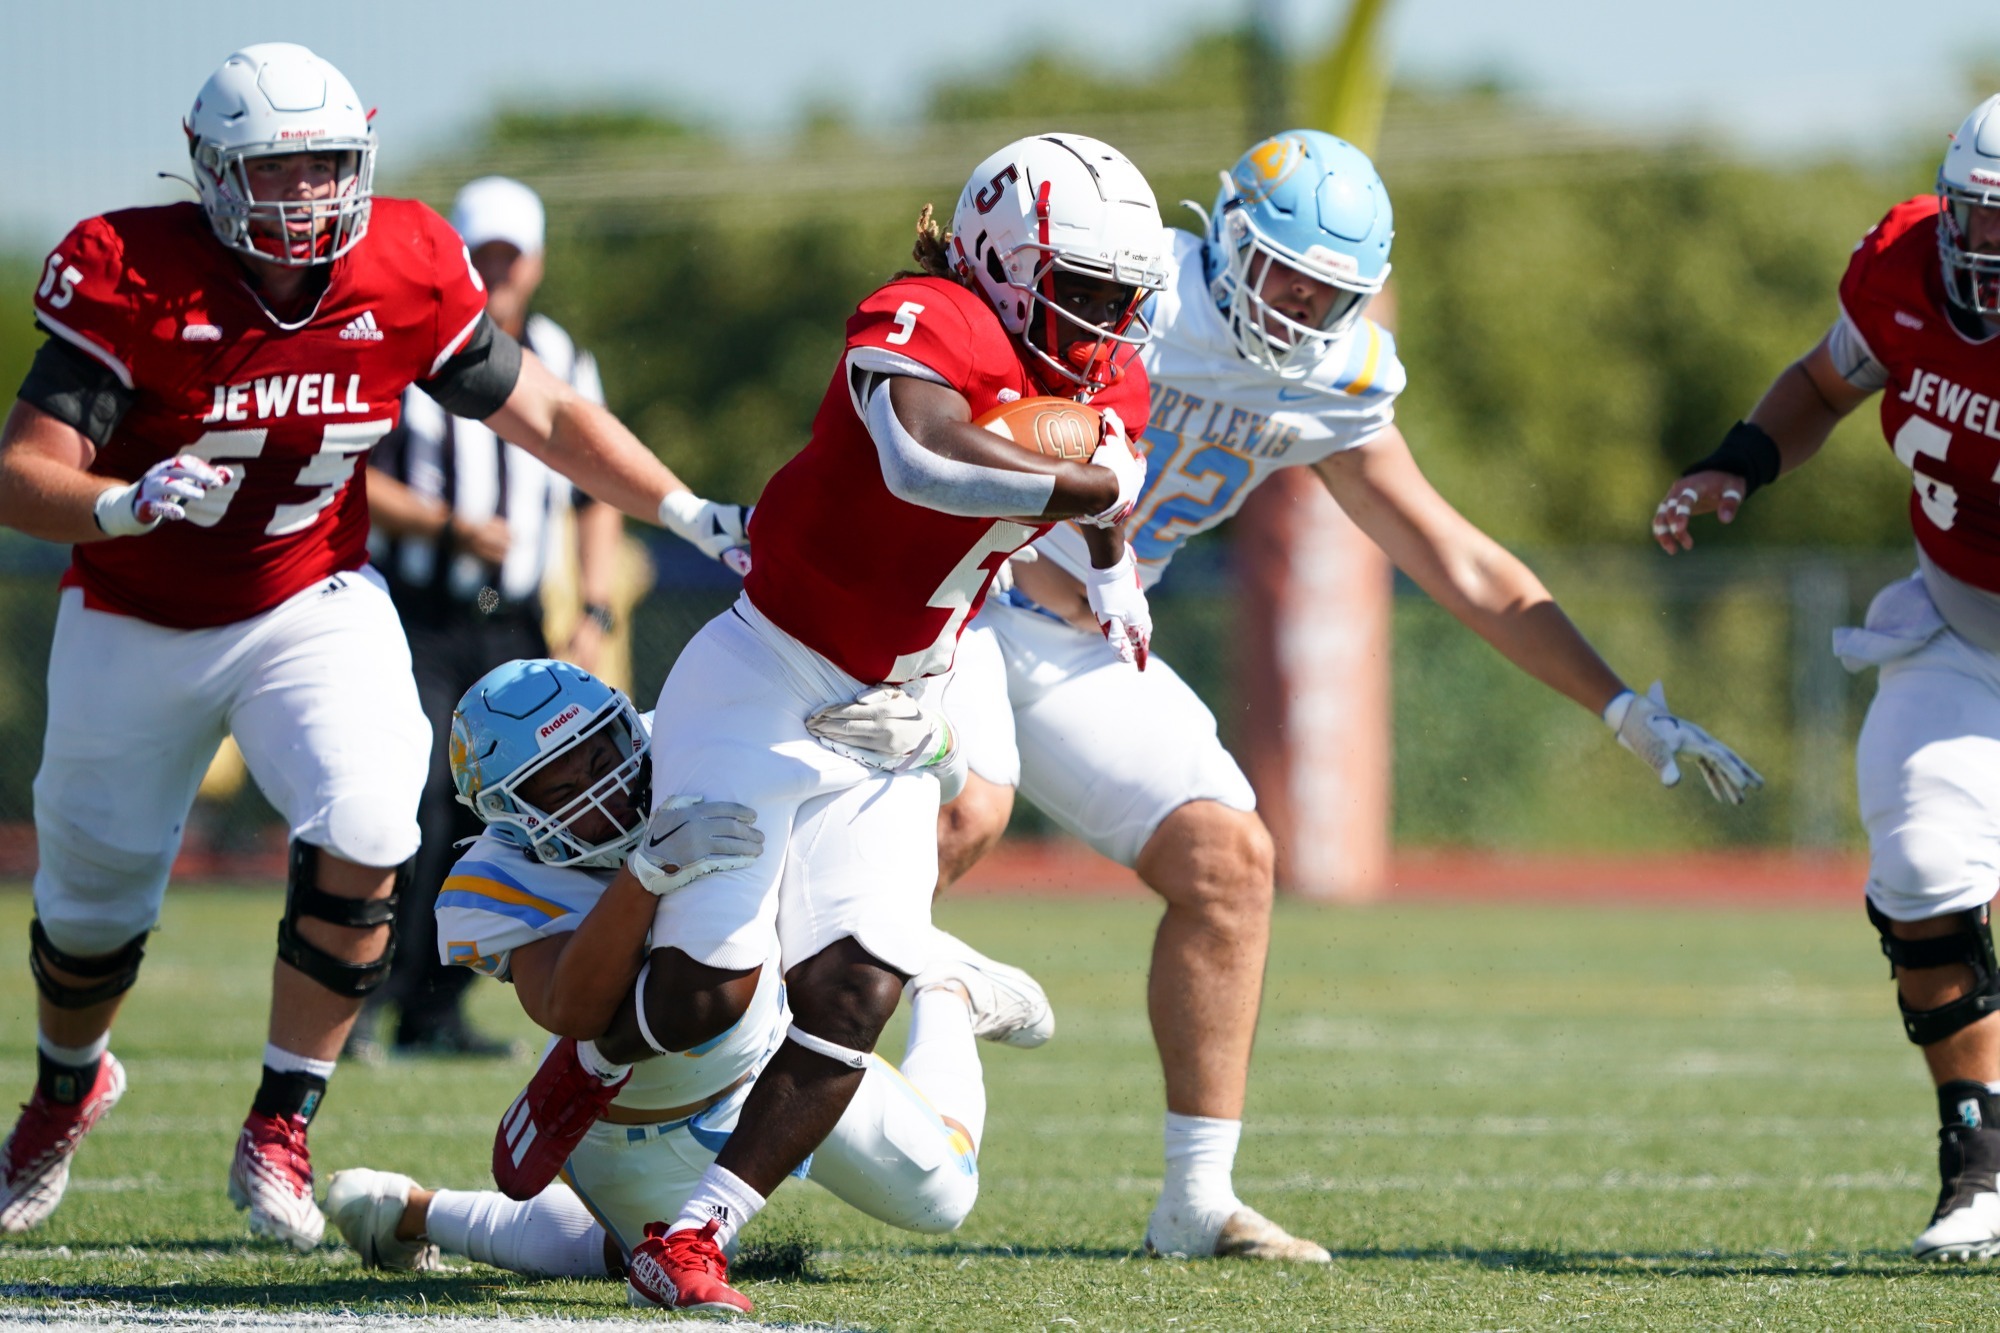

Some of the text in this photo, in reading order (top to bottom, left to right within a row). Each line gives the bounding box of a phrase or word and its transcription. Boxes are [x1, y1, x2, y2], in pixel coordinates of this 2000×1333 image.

[975, 163, 1021, 215] 5
[339, 329, 385, 342] adidas
[885, 301, 926, 346] 5
[202, 372, 371, 424] JEWELL
[1899, 367, 2000, 441] JEWEL
[1200, 402, 1302, 460] LEWIS
[882, 520, 1040, 683] 5
[540, 704, 581, 738] Riddell
